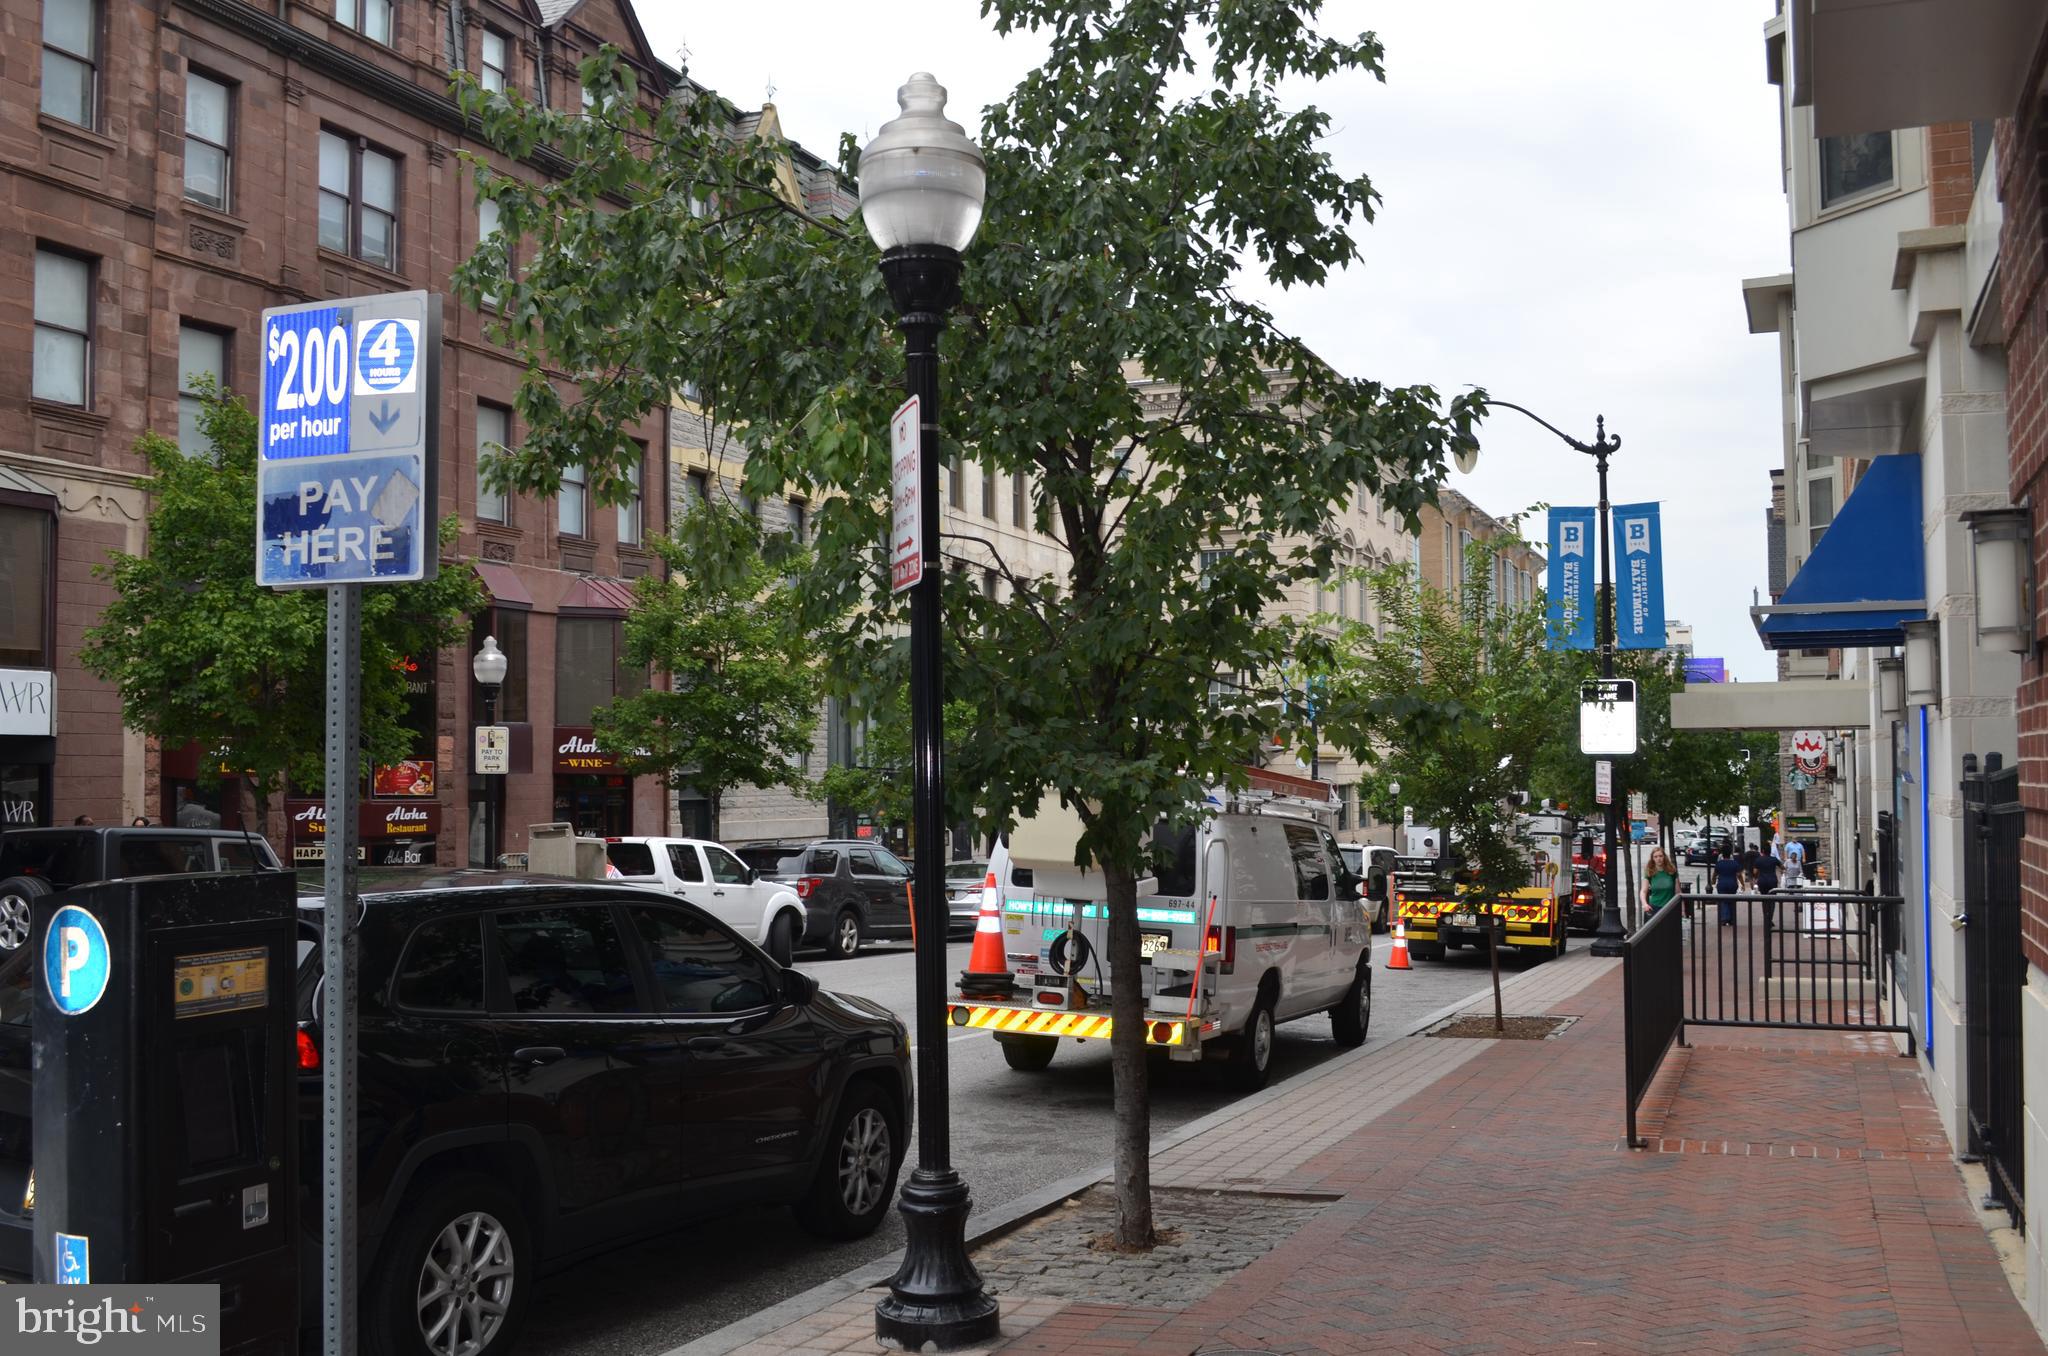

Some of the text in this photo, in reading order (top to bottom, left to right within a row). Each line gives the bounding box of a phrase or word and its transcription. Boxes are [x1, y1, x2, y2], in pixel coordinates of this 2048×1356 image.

[369, 323, 400, 365] 4
[269, 324, 348, 410] $2.00
[270, 415, 342, 446] per hour
[299, 476, 378, 516] PAY
[283, 526, 395, 565] HERE
[1564, 526, 1579, 542] B
[1630, 524, 1645, 540] B
[1631, 560, 1643, 634] BALTIMORE
[1641, 559, 1649, 617] UNIVERSITY OF
[3, 800, 34, 823] WR
[386, 807, 428, 821] Aloha
[386, 823, 427, 833] Restaurant
[296, 848, 326, 858] HAPP
[404, 850, 421, 864] Bar
[1168, 899, 1195, 908] 697-44
[60, 927, 90, 997] P
